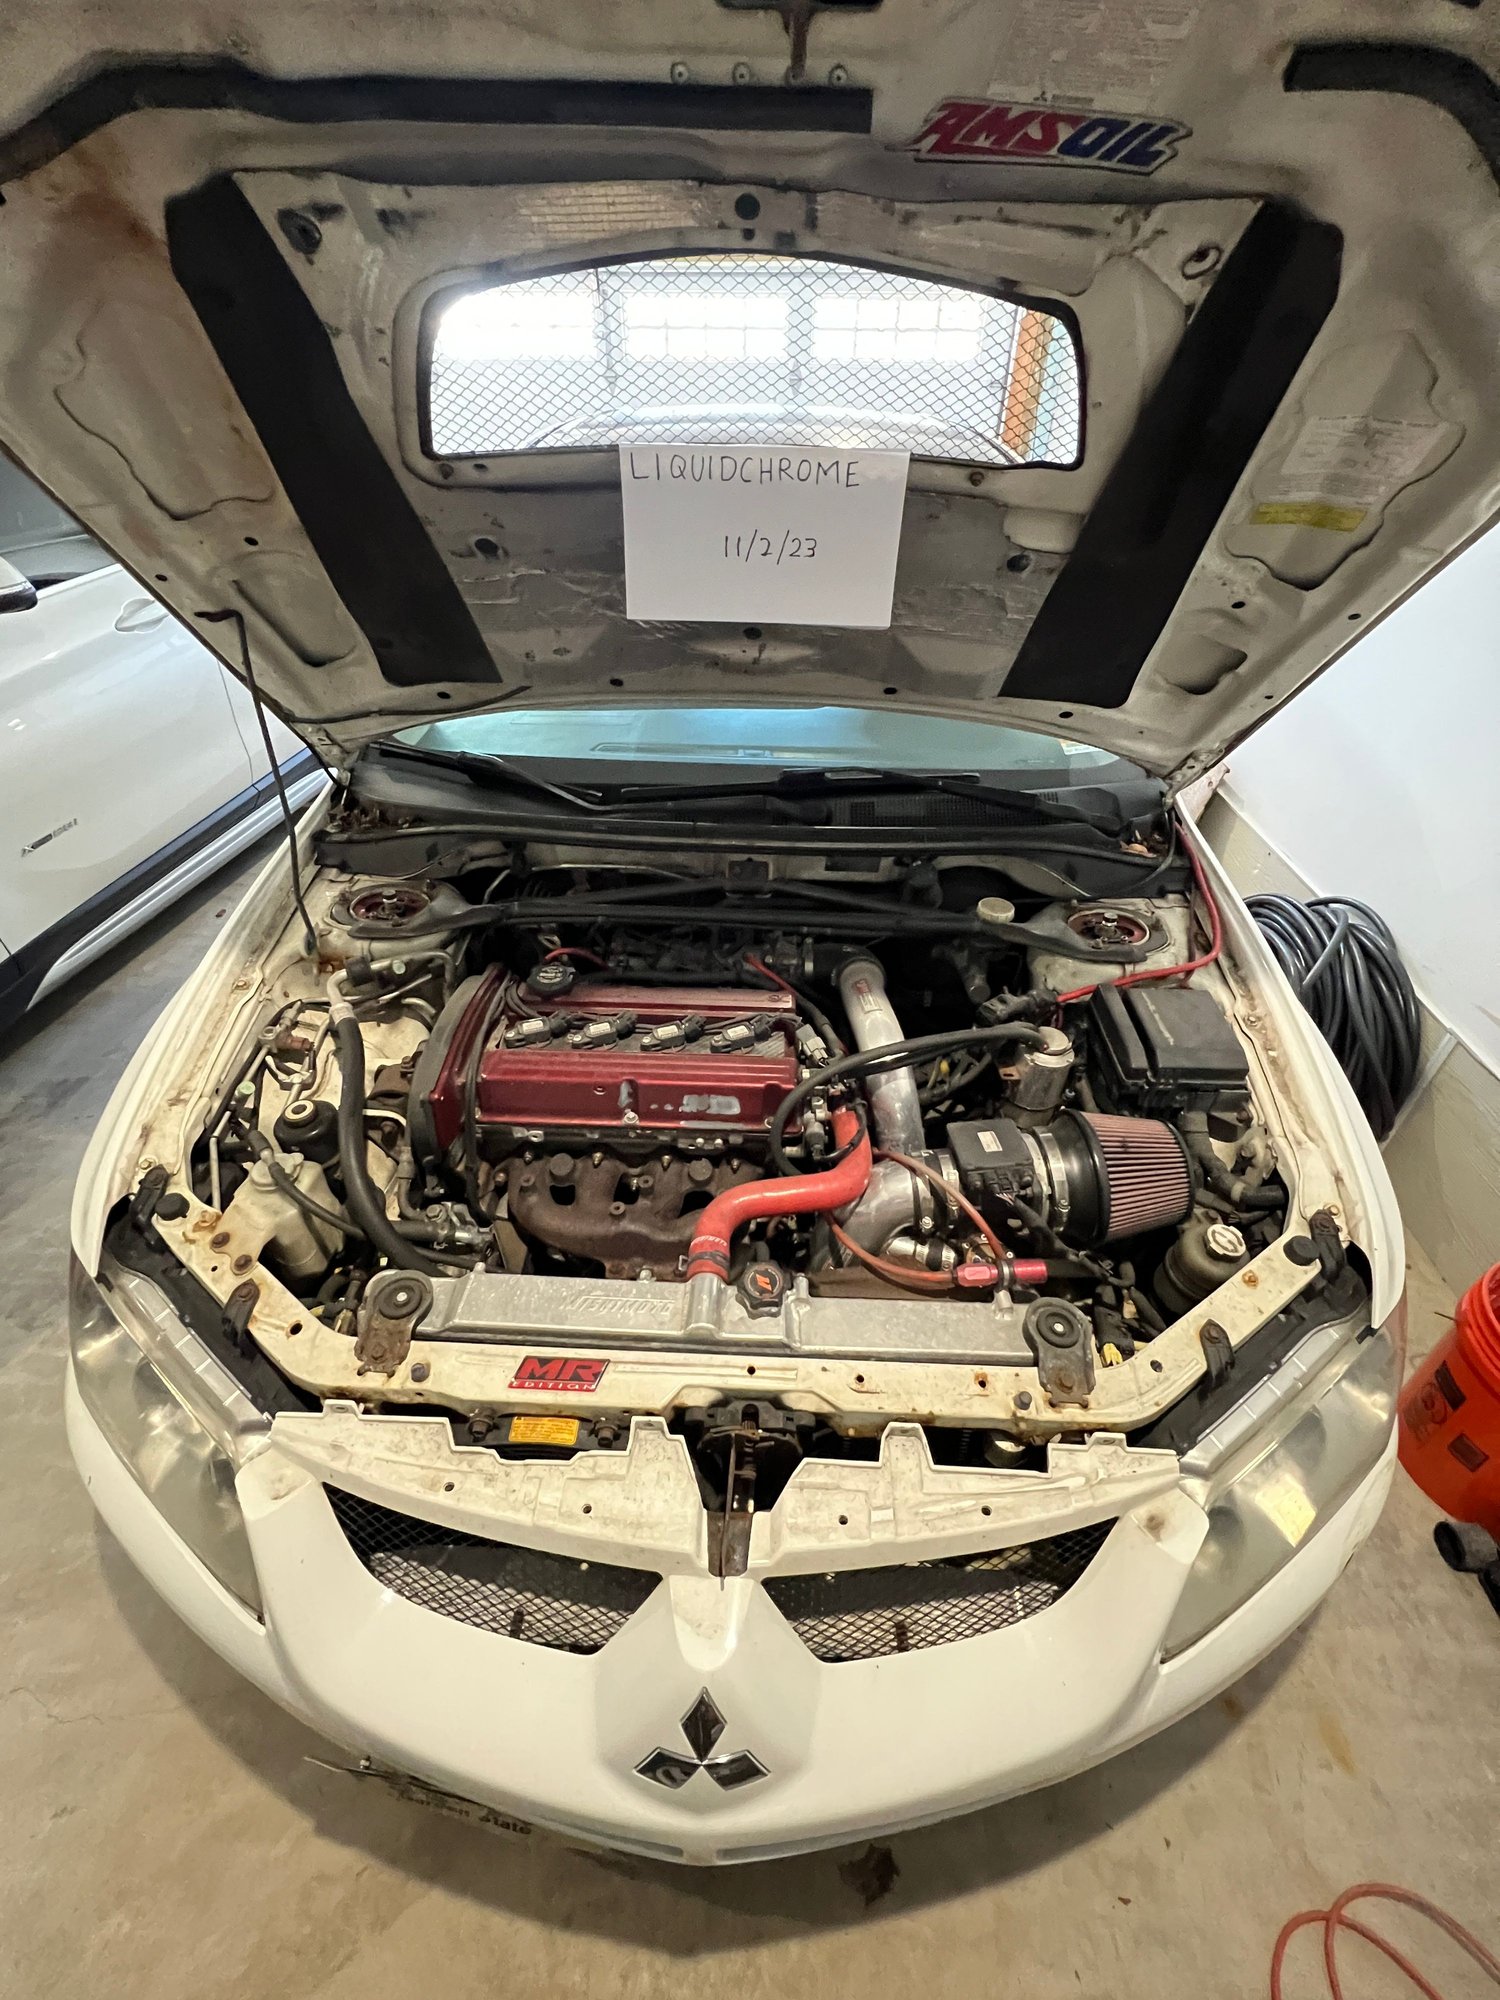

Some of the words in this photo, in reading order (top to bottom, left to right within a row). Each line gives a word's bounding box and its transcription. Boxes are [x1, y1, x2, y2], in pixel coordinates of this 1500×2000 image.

[910, 101, 1178, 166] AMSOIL
[629, 452, 860, 488] LIQUIDCHROME
[724, 529, 817, 565] 11/2/23
[511, 1381, 596, 1390] EDITION
[516, 1359, 605, 1381] MR
